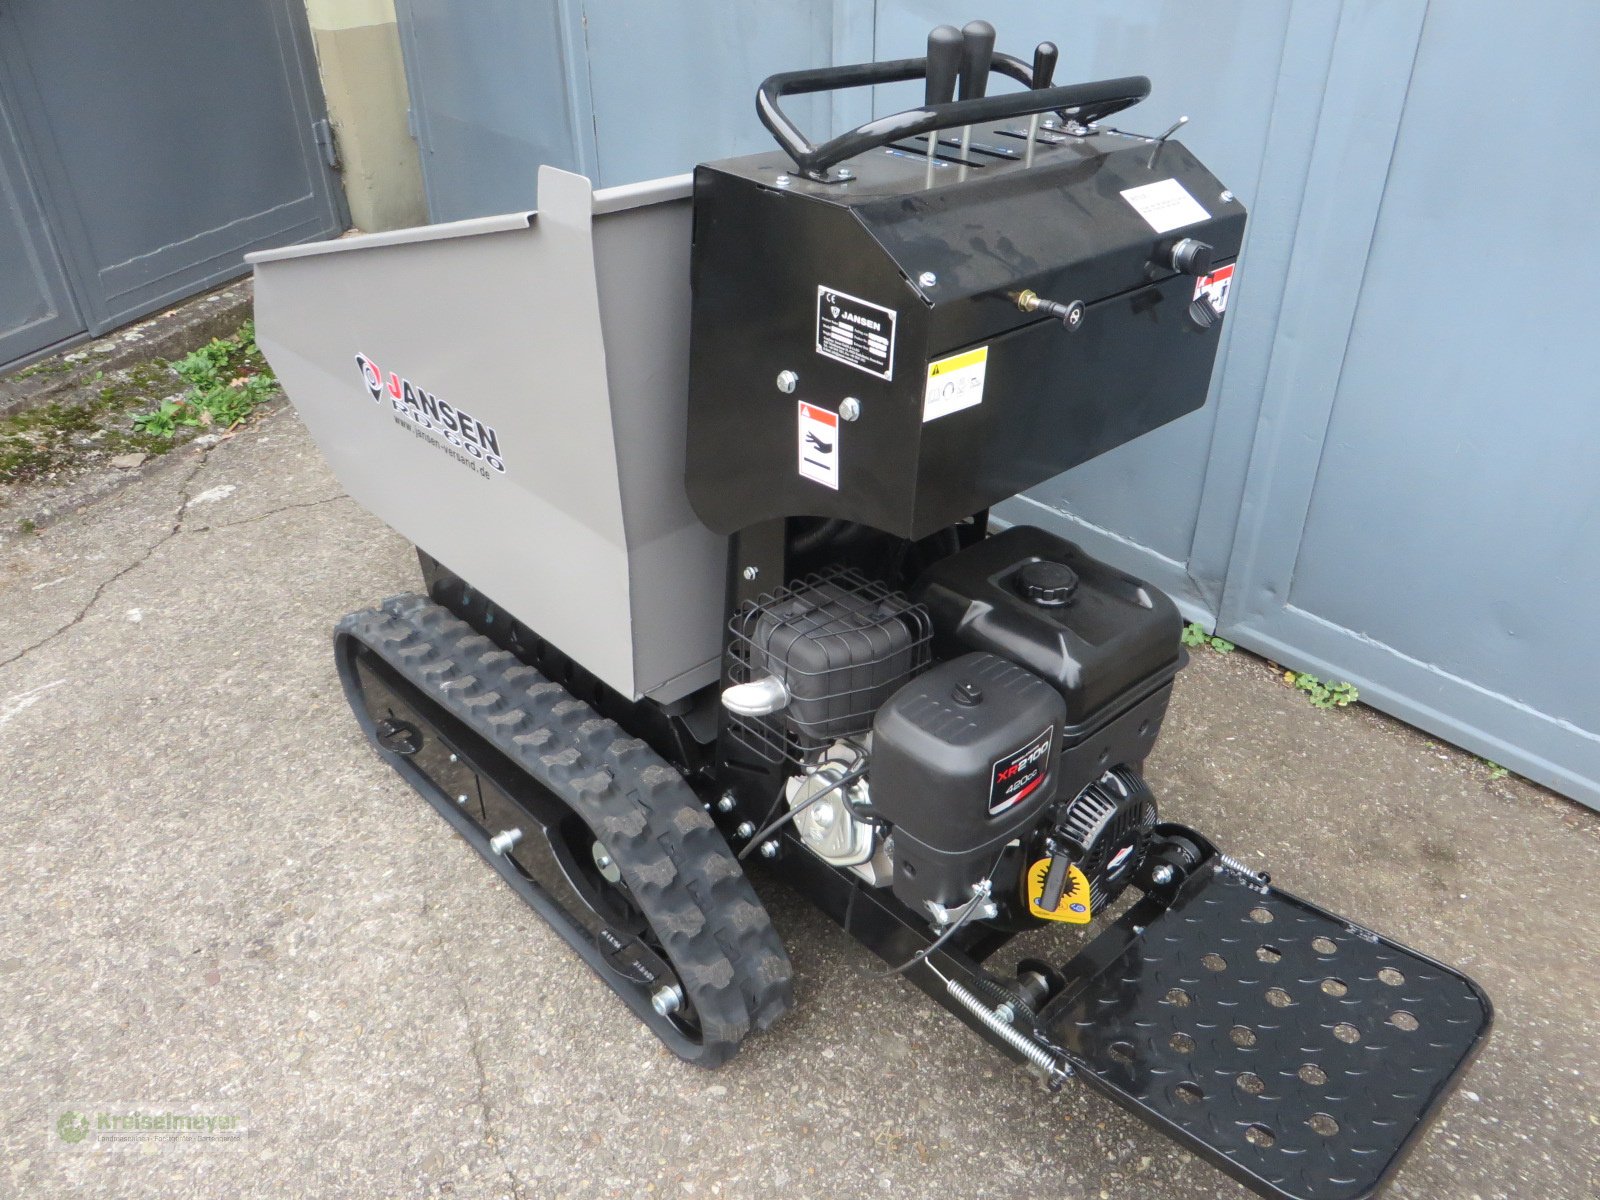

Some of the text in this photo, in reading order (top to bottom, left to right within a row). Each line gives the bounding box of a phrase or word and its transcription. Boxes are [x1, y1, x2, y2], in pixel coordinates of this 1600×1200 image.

[841, 311, 881, 332] JANSEN
[386, 371, 502, 459] JANSEN
[391, 399, 506, 474] RD-600
[394, 415, 491, 480] www.jansen-versand.de
[997, 741, 1049, 783] XR2100
[1006, 769, 1037, 794] 420cc
